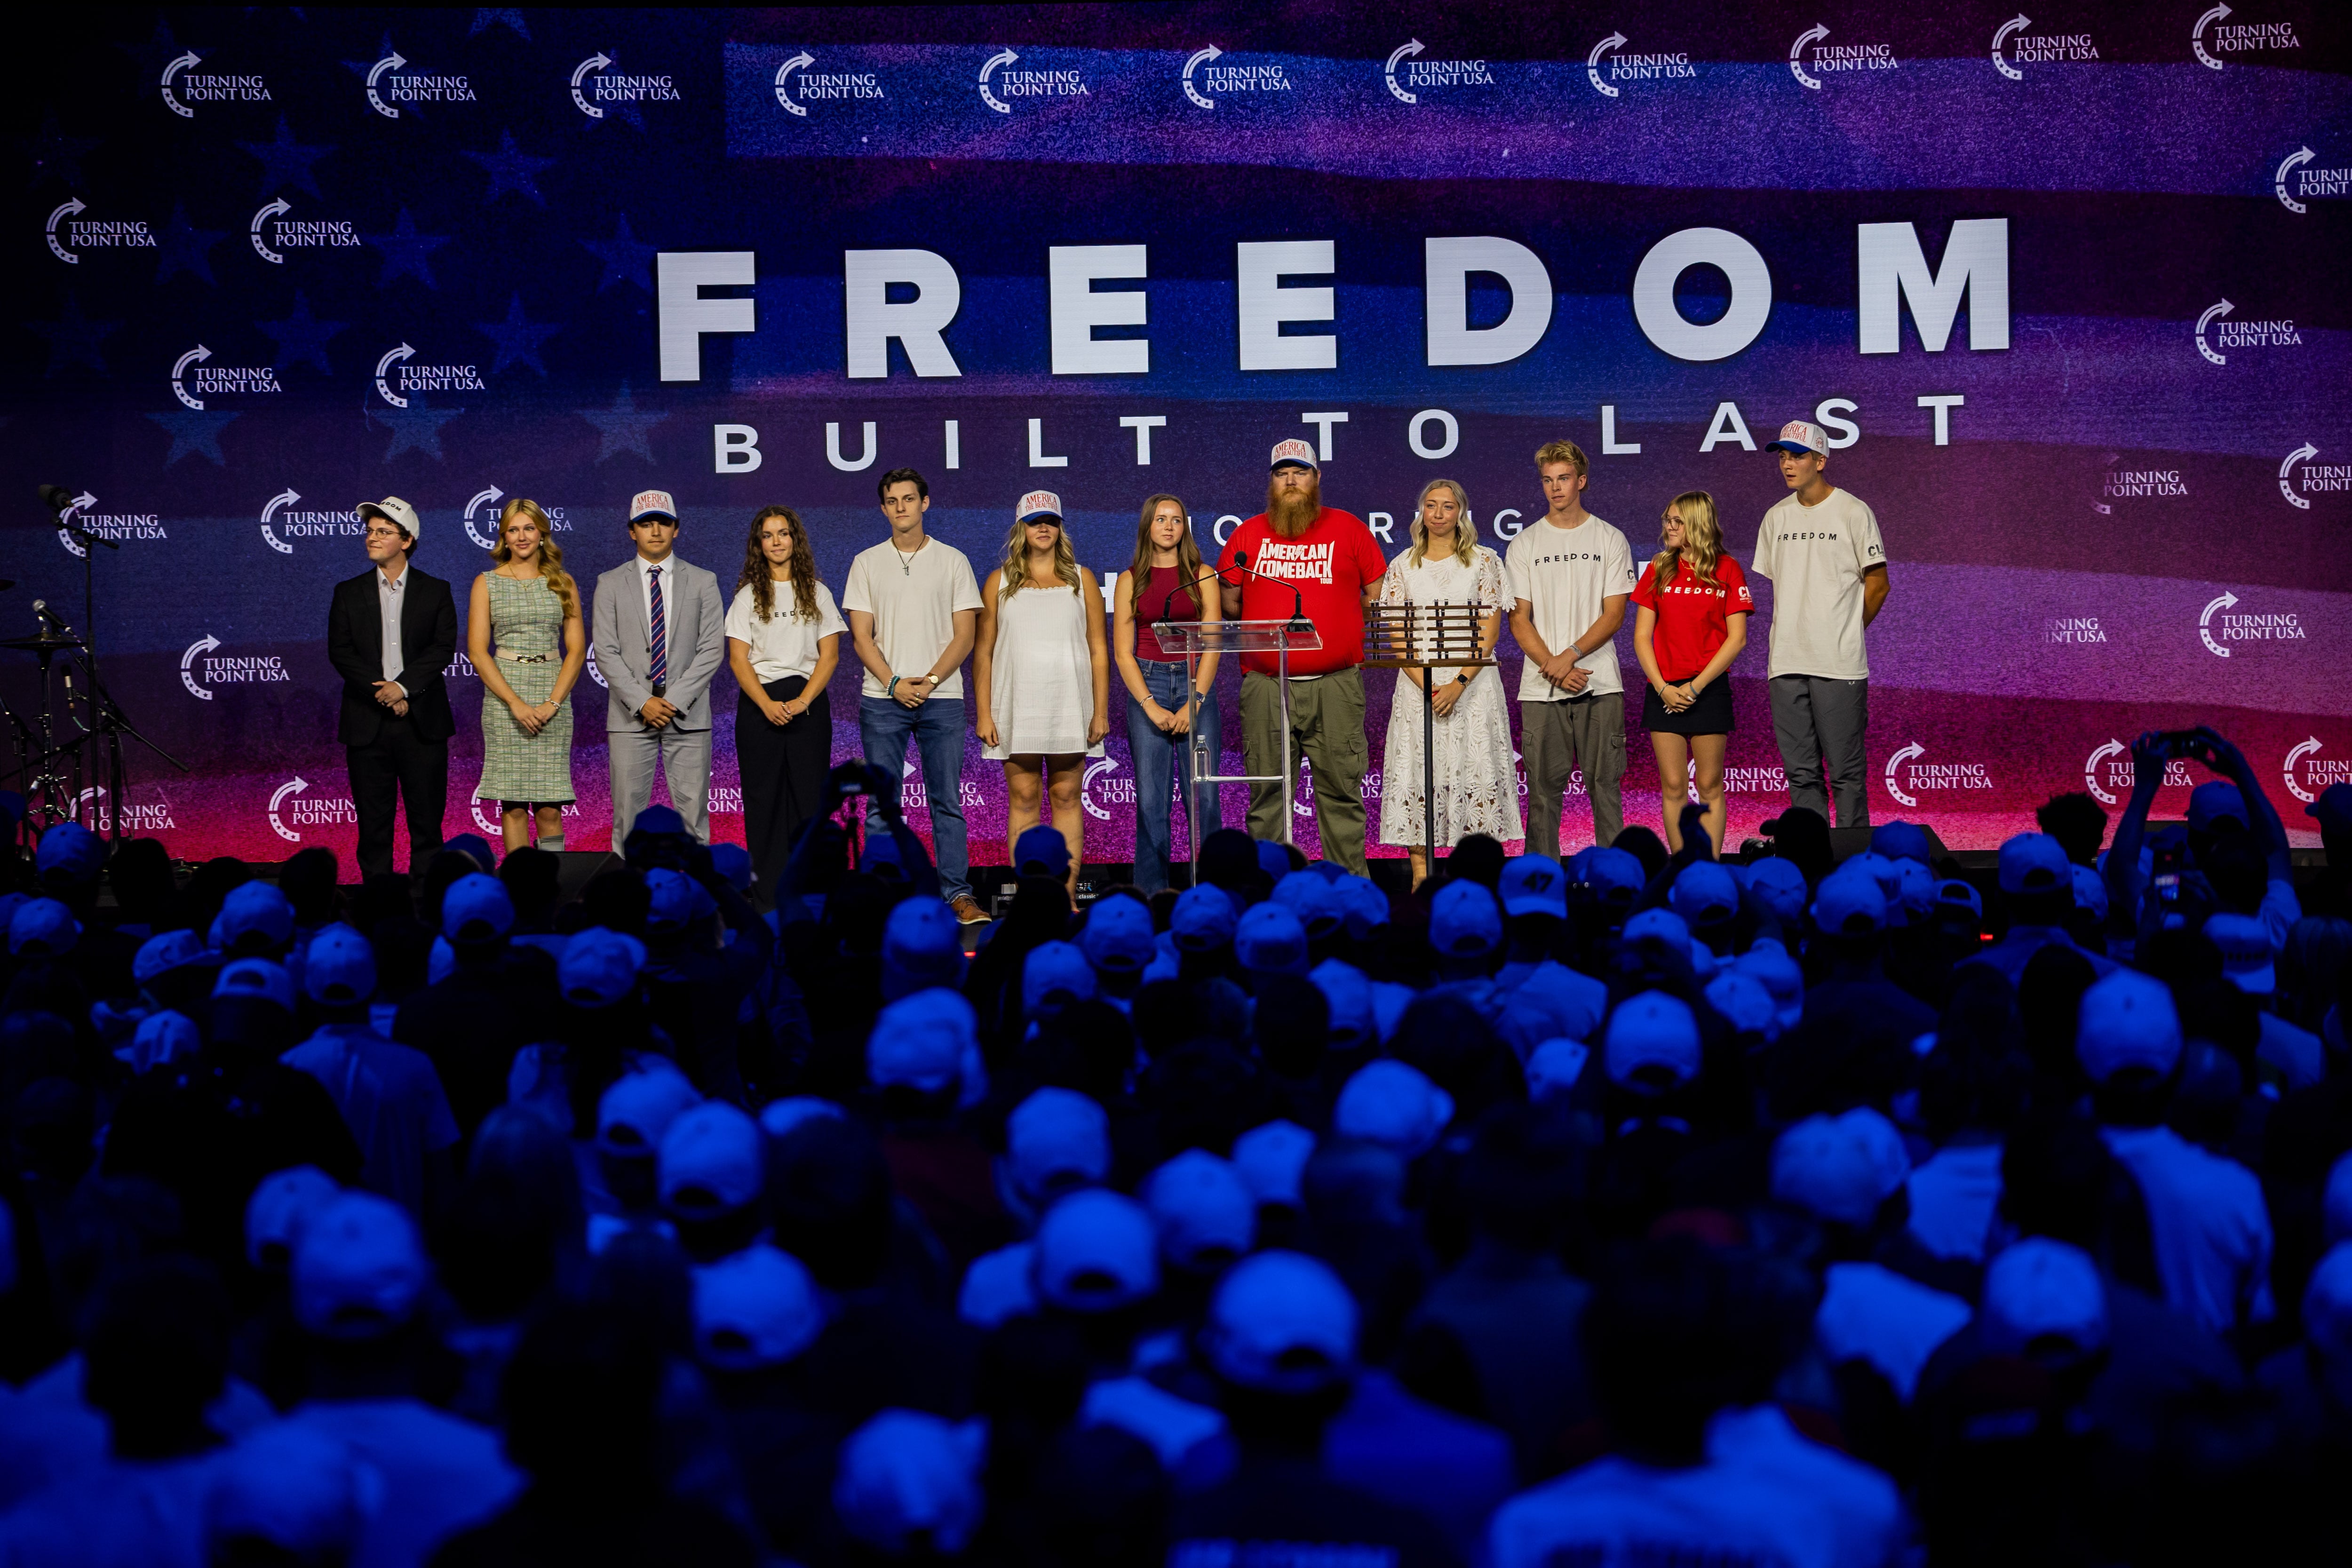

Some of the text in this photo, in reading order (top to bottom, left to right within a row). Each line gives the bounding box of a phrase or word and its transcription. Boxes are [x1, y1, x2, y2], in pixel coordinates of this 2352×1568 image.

[2215, 23, 2291, 38] TURNING
[2015, 35, 2090, 49] TURNING
[2217, 36, 2299, 51] POINT USA
[1813, 45, 1889, 59] TURNING
[2016, 46, 2098, 62] POINT USA
[1611, 53, 1687, 67] TURNING
[1815, 57, 1898, 72] POINT USA
[1205, 66, 1282, 79] TURNING
[1408, 60, 1485, 74] TURNING
[1612, 65, 1696, 79] POINT USA
[184, 75, 262, 87] TURNING
[389, 77, 467, 88] TURNING
[594, 76, 671, 88] TURNING
[798, 74, 875, 87] TURNING
[1002, 71, 1079, 83] TURNING
[1409, 72, 1494, 86] POINT USA
[1003, 83, 1089, 96] POINT USA
[1207, 78, 1291, 91] POINT USA
[186, 88, 271, 100] POINT USA
[391, 89, 476, 100] POINT USA
[596, 88, 680, 100] POINT USA
[800, 86, 884, 98] POINT USA
[2298, 168, 2352, 183] TURNI
[2300, 182, 2349, 195] POINT
[69, 222, 147, 233] TURNING
[274, 222, 351, 234] TURNING
[72, 235, 156, 246] POINT USA
[276, 234, 360, 246] POINT USA
[657, 219, 2009, 381] FREEDOM
[2218, 320, 2293, 334] TURNING
[2219, 332, 2302, 347] POINT USA
[195, 368, 272, 380] TURNING
[399, 366, 476, 379] TURNING
[197, 381, 281, 392] POINT USA
[400, 378, 485, 390] POINT USA
[715, 396, 1964, 473] BUILT TO LAST
[1275, 442, 1306, 454] AMERICA
[1282, 450, 1307, 459] BEAUTIFUL
[2158, 484, 2187, 495] USA
[2303, 478, 2352, 491] POINT
[637, 493, 668, 505] AMERICA
[1026, 493, 1057, 505] AMERICA
[645, 502, 670, 511] BEAUTIFUL
[1025, 502, 1058, 512] THE BEAUTIFUL
[81, 515, 158, 526] TURNING
[284, 511, 360, 523] TURNING
[137, 527, 167, 539] USA
[286, 524, 336, 536] POINT
[1778, 532, 1837, 542] FREEDOM
[1535, 553, 1601, 566] FREEDOM
[1259, 559, 1333, 579] COMEBACK
[1664, 586, 1725, 598] REEDOM
[2222, 614, 2296, 628] TURNING
[2077, 629, 2106, 642] USA
[2224, 626, 2305, 639] POINT USA
[204, 657, 280, 669] TURNING
[206, 669, 290, 682] POINT USA
[1908, 764, 1984, 776] TURNING
[2306, 761, 2352, 772] TURN
[1724, 780, 1789, 791] OINT USA
[1909, 777, 1993, 789] POINT USA
[2109, 774, 2193, 786] POI USA
[292, 799, 356, 812] TURNIN
[901, 796, 926, 807] POI
[561, 805, 580, 816] SA
[145, 817, 175, 829] USA
[293, 812, 343, 824] POINT
[1523, 871, 1554, 893] 47
